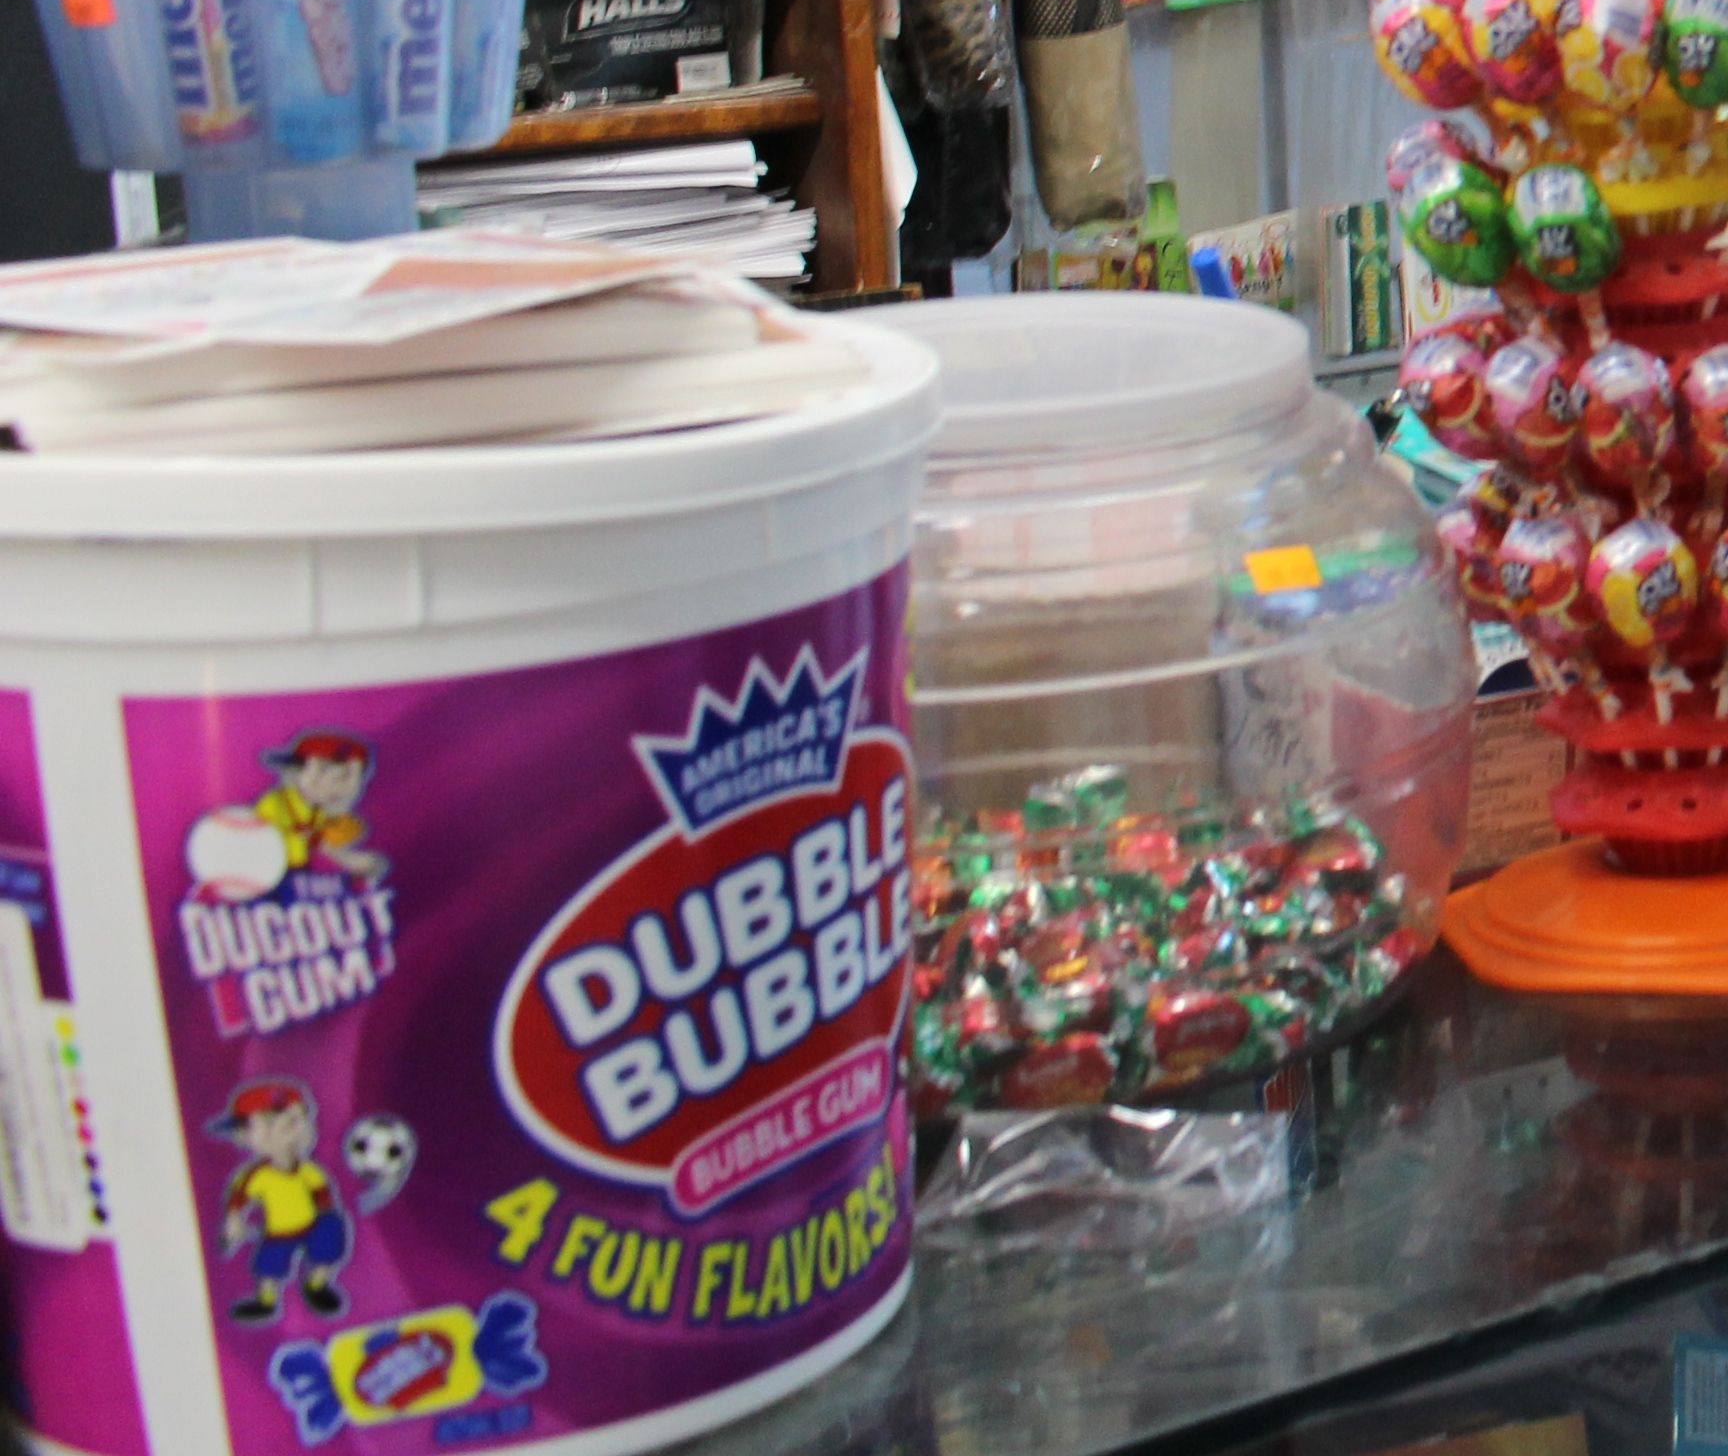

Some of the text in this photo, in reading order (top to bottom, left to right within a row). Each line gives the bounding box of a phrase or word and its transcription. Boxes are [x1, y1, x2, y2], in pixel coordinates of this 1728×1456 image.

[681, 700, 843, 793] AMERICA'S
[694, 755, 828, 815] ORIGINAL
[180, 889, 394, 981] DUGOUT
[545, 778, 908, 1044] DUBBLE
[244, 947, 377, 1035] GUM
[586, 878, 908, 1141] BUBBLE
[690, 1059, 888, 1194] BUBBLE GUM
[486, 1141, 899, 1320] 4 FUN FLAVORS!
